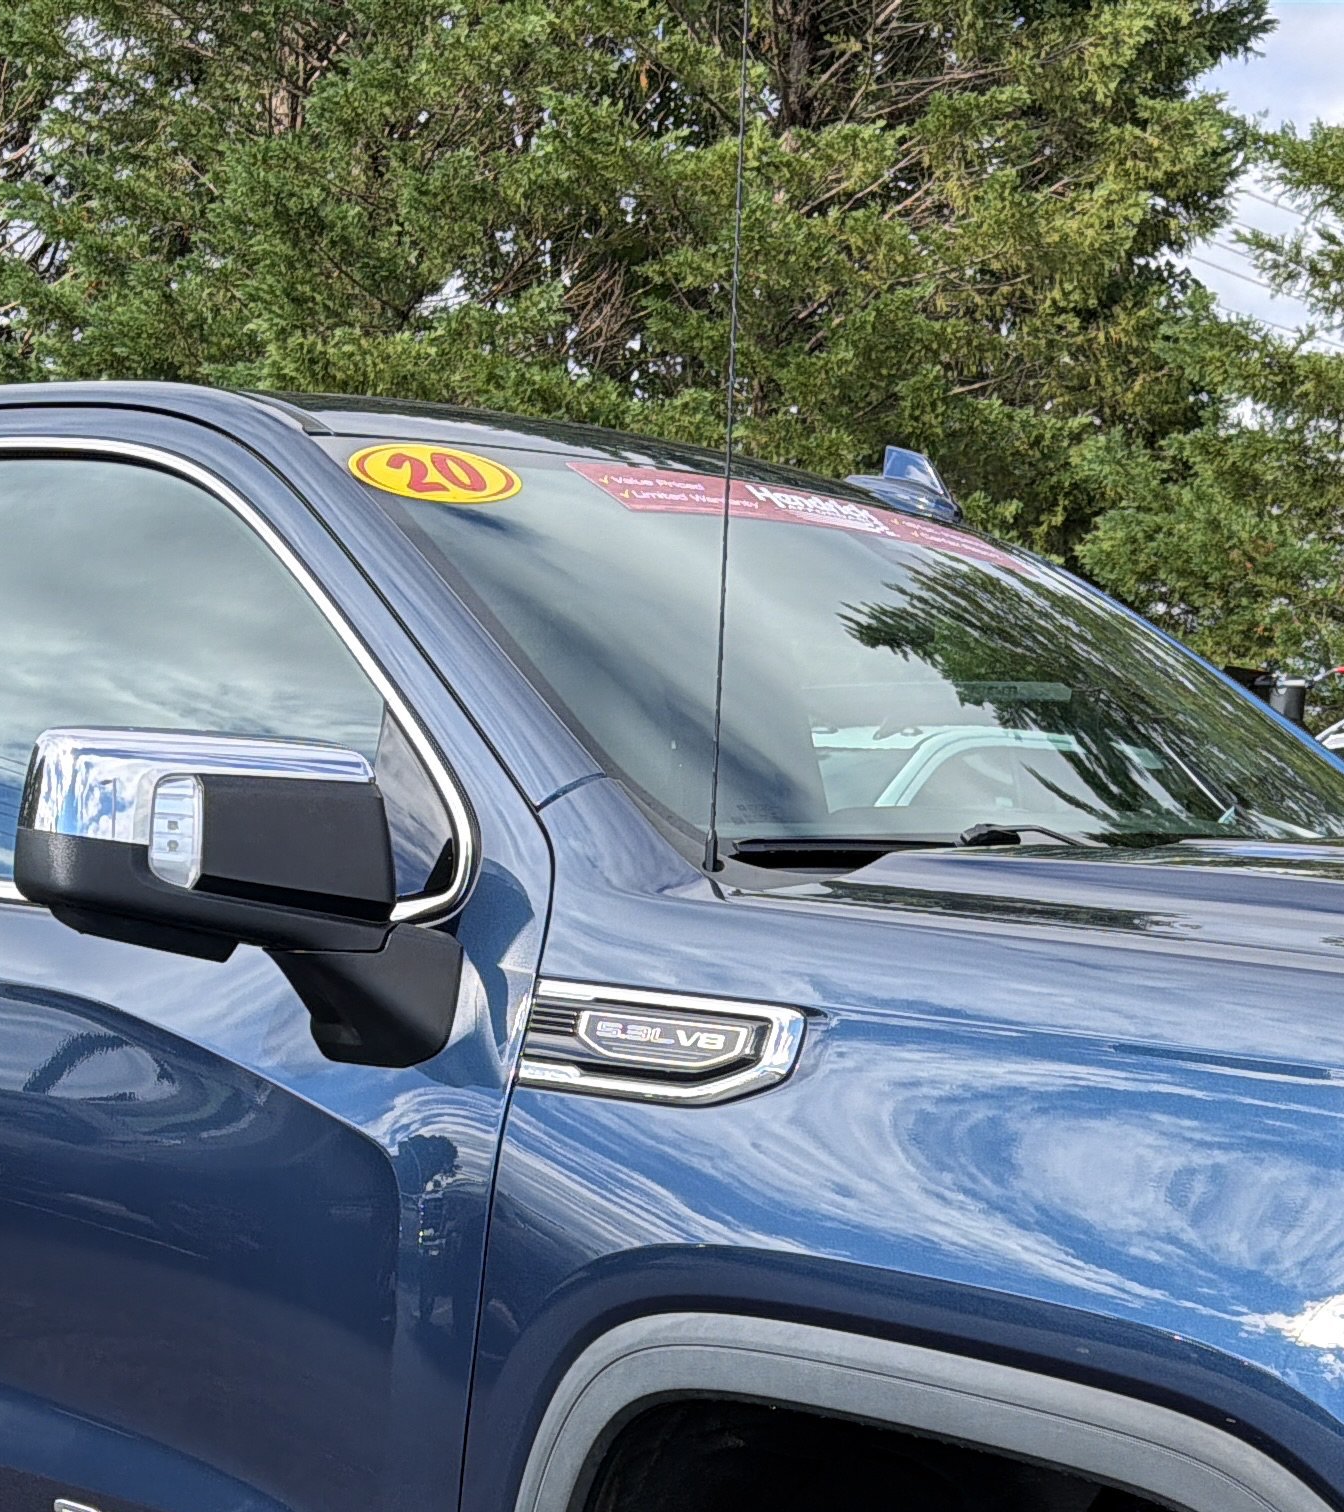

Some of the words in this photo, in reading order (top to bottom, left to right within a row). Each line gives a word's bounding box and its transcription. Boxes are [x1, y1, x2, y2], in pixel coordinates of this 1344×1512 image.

[386, 452, 487, 492] 20
[610, 475, 654, 487] Value
[656, 478, 705, 491] Priced
[631, 490, 689, 501] Limited
[675, 1029, 726, 1050] V8
